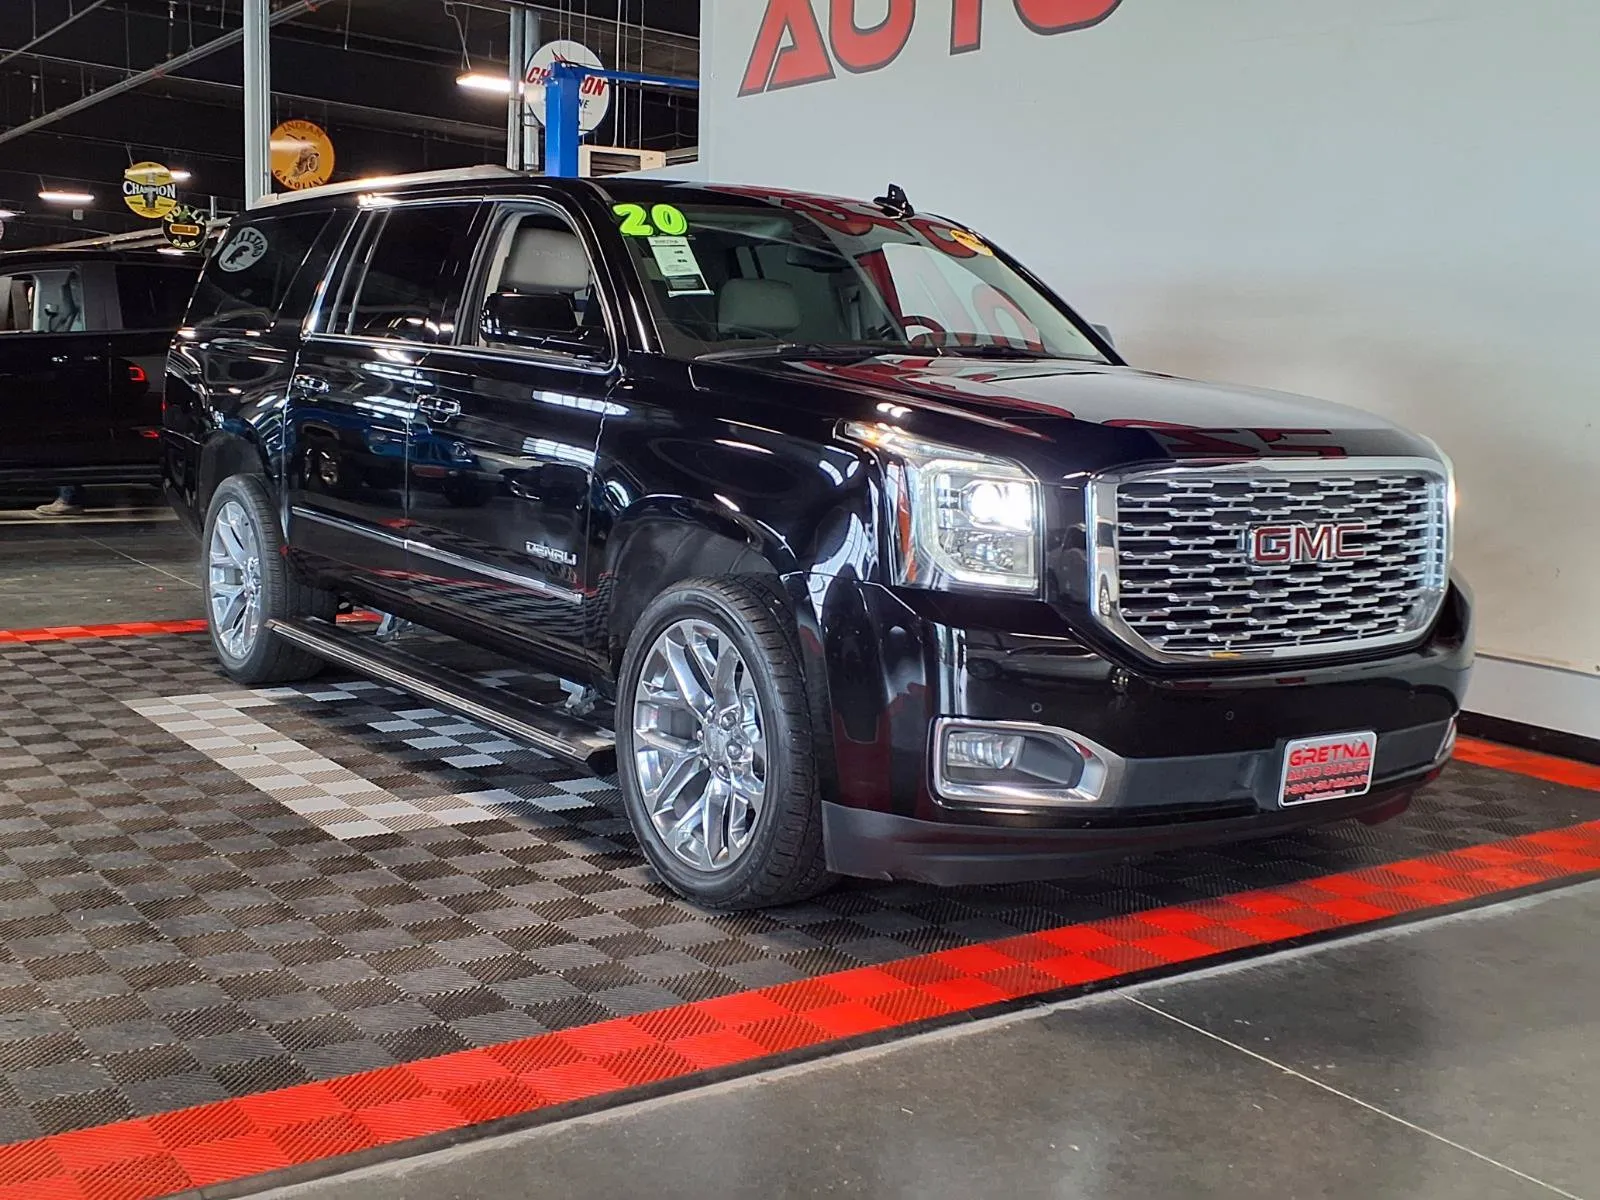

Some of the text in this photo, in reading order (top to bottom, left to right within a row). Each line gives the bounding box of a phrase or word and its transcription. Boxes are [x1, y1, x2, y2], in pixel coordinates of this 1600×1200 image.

[737, 0, 1124, 98] AU
[526, 66, 605, 96] CHON
[612, 203, 688, 236] 20
[172, 238, 197, 249] GAS
[525, 541, 577, 565] DENALI
[1253, 523, 1367, 563] GMC
[1288, 742, 1371, 767] GRETNA
